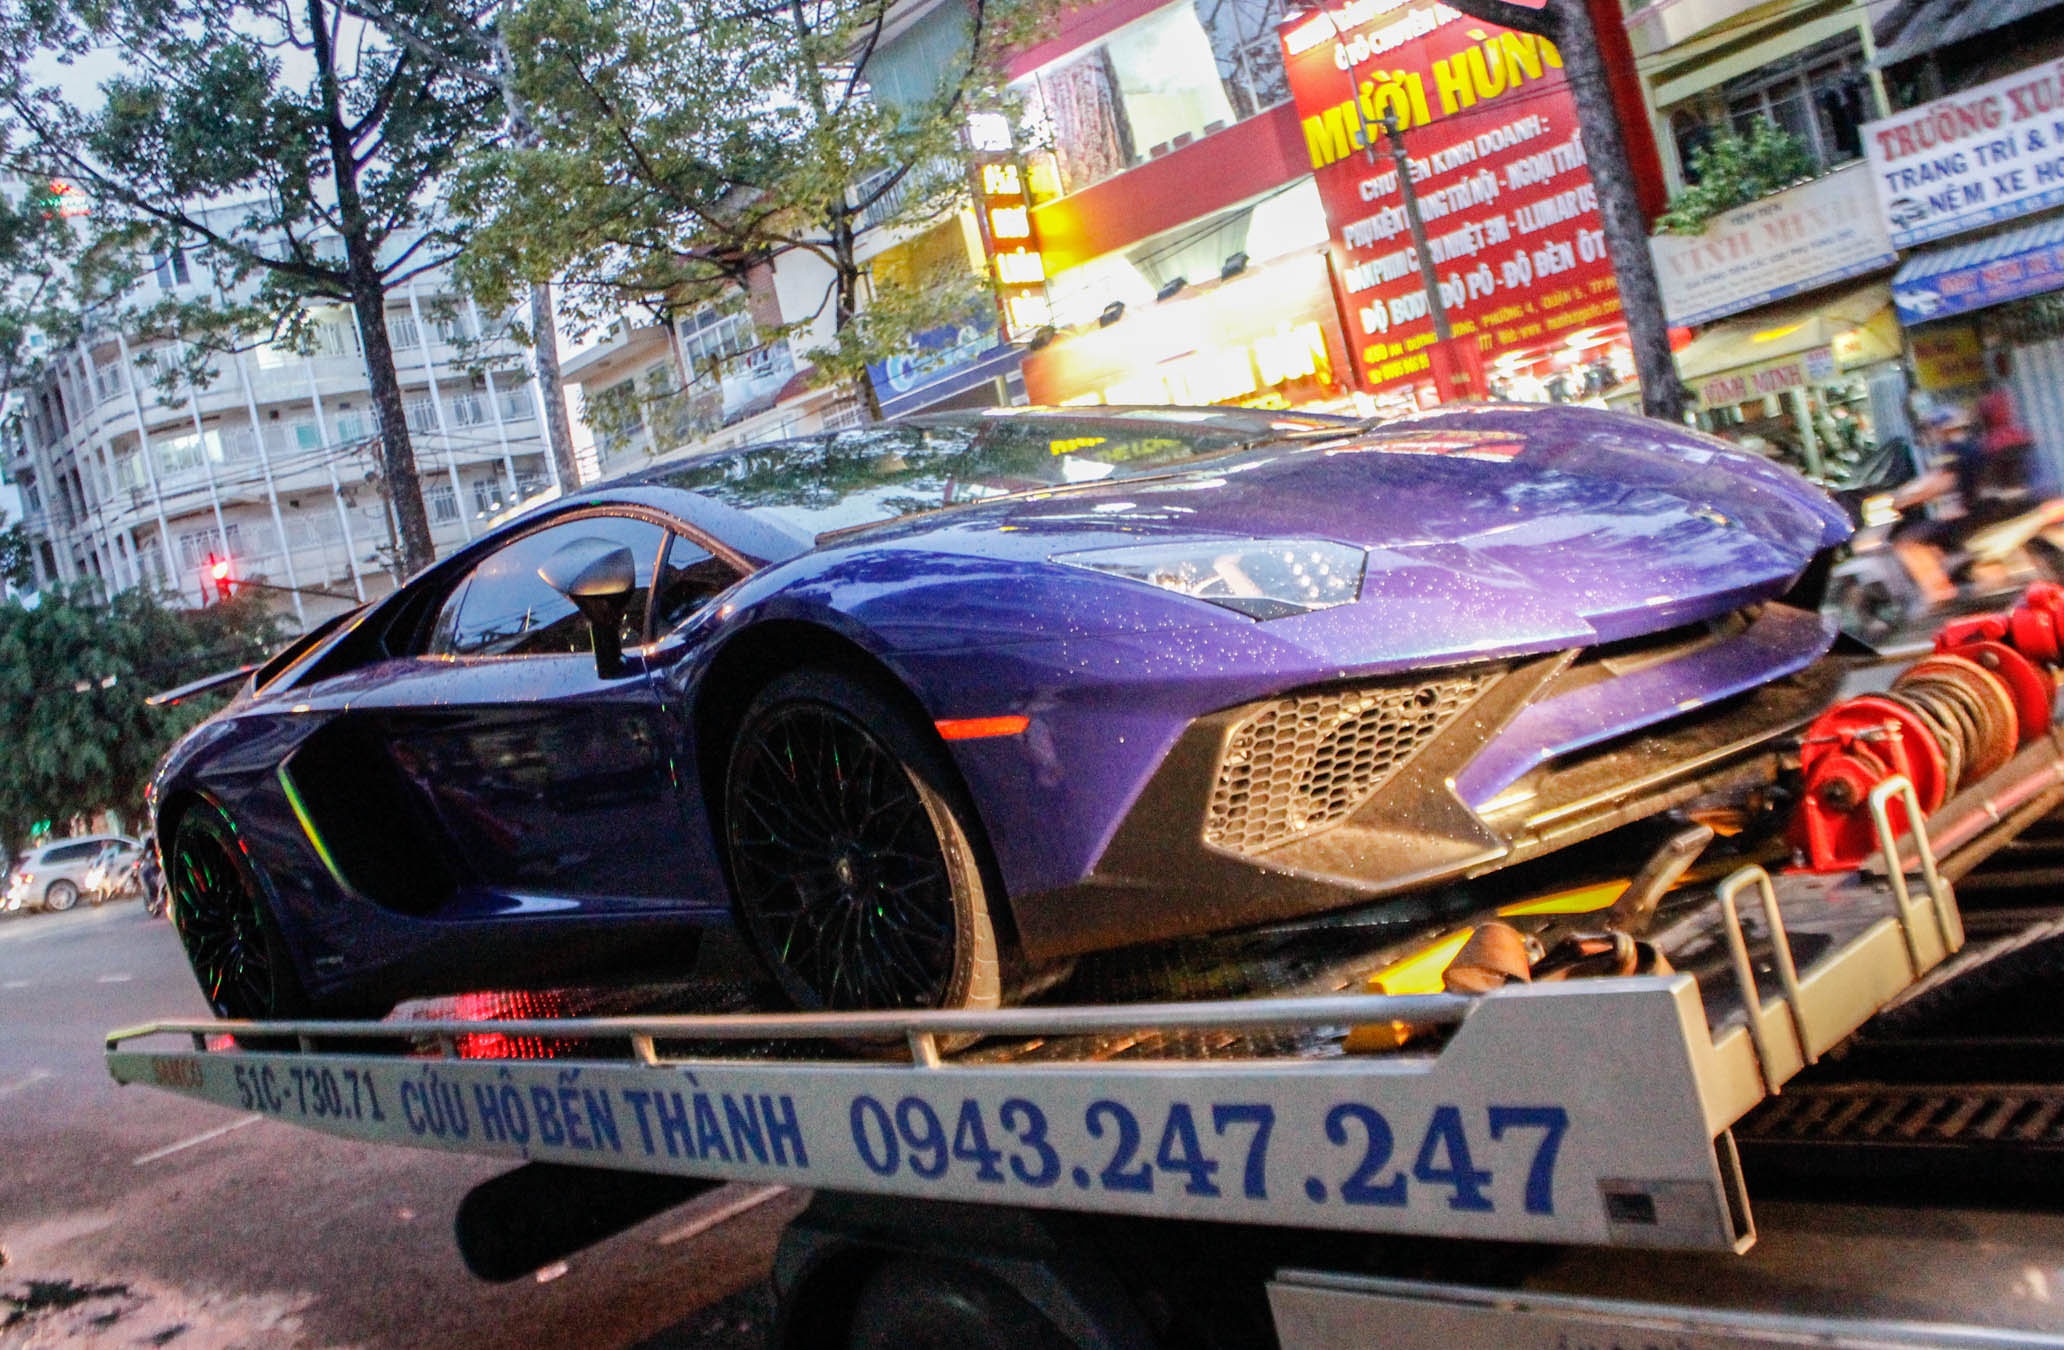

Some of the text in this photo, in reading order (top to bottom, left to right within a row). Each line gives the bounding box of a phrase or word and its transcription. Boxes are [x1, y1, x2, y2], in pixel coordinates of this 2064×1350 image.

[1302, 70, 1432, 169] MƯỜI
[1359, 157, 1433, 202] CHUÊN
[1430, 140, 1477, 175] KINH
[1883, 152, 1968, 192] TRANG
[1973, 130, 2018, 167] TRÍ
[2027, 128, 2047, 152] &
[1993, 169, 2027, 195] XE
[233, 1063, 385, 1122] 51C-730.71
[400, 1063, 469, 1141] CỨU
[473, 1064, 531, 1160] HỘ
[529, 1067, 624, 1154] BẾN
[622, 1069, 811, 1169] THÀNH
